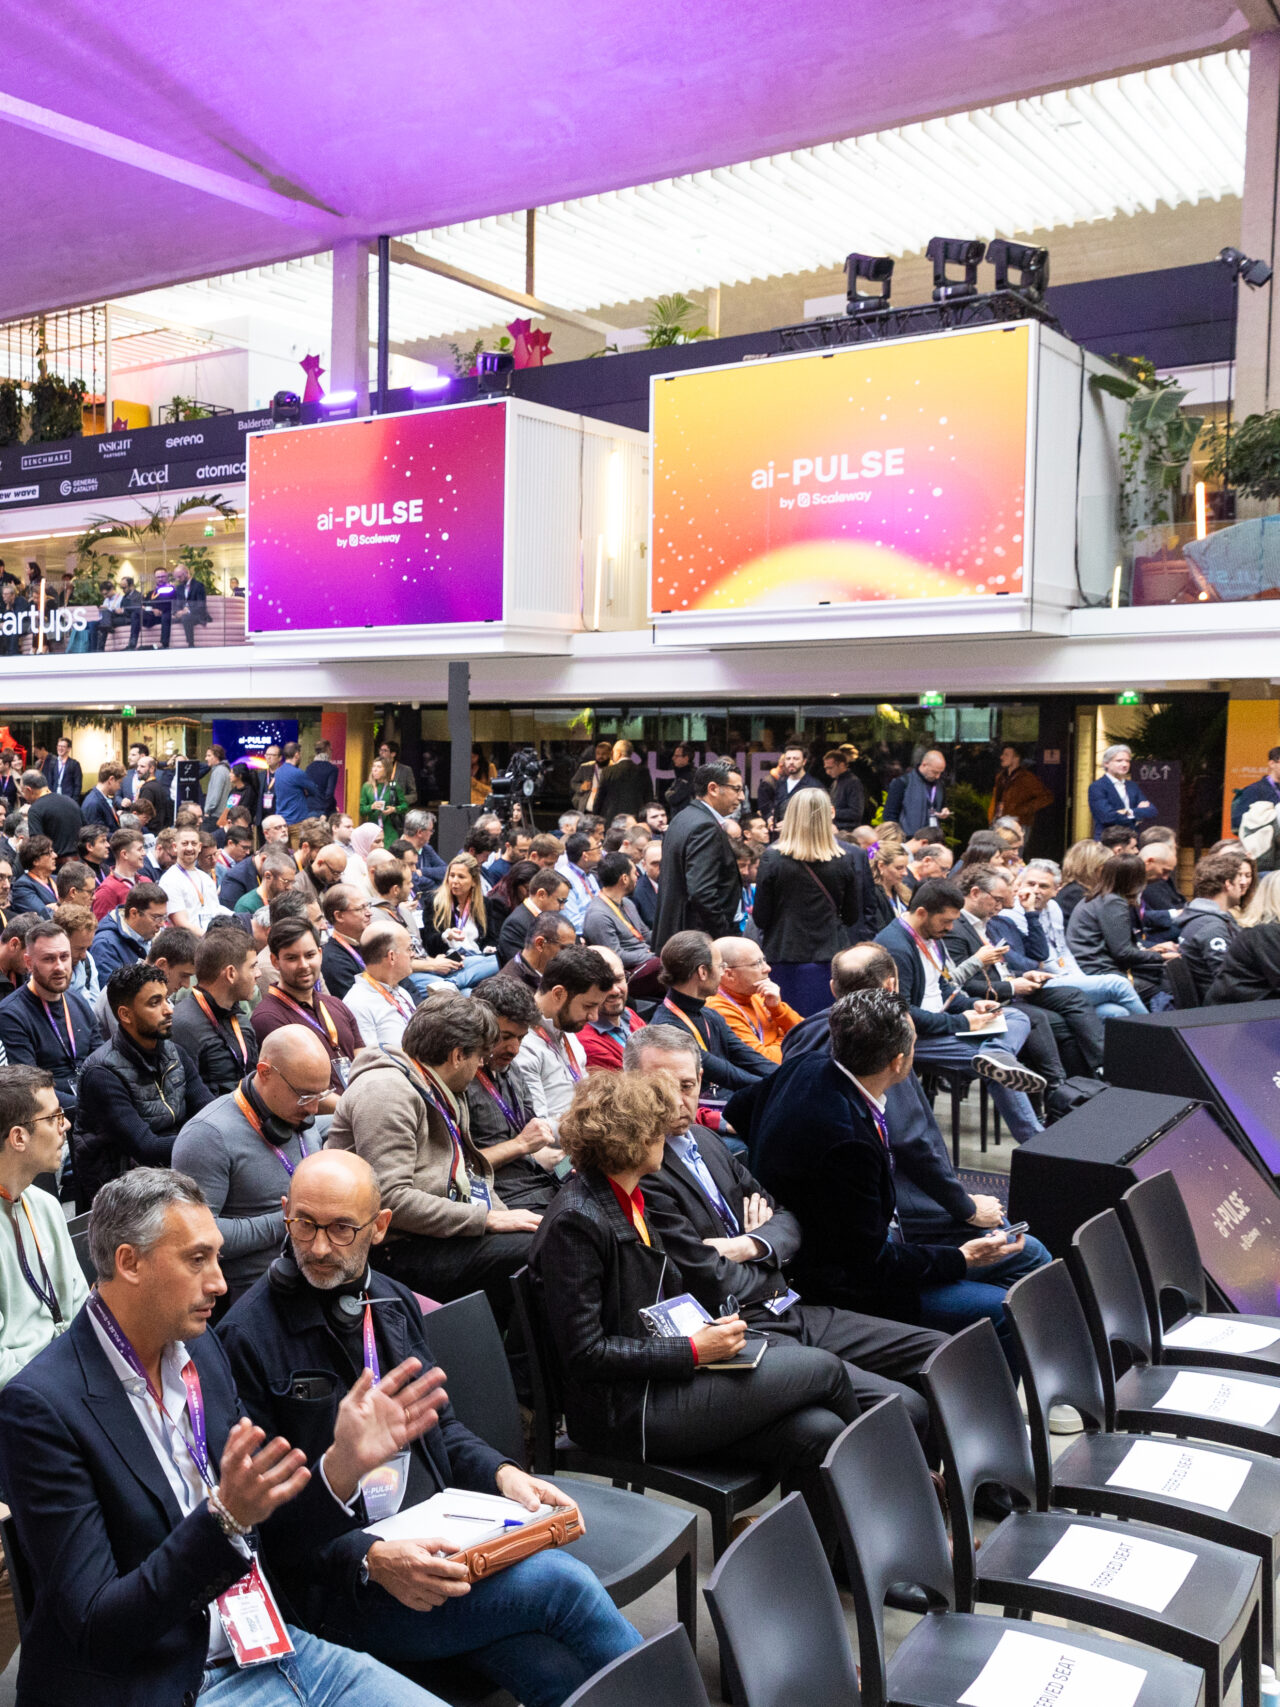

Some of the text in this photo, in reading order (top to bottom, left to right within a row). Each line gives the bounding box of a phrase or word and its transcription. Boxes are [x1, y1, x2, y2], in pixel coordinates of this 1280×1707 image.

[238, 418, 274, 430] Balderton
[98, 439, 132, 453] INSIGHT
[165, 434, 204, 448] serena
[23, 454, 68, 467] BENCHMARK
[128, 464, 168, 488] Accel
[751, 448, 905, 490] ai-PULSE
[72, 478, 98, 486] GENERAL
[72, 484, 98, 494] CATALYST
[14, 488, 36, 497] wave
[779, 490, 872, 510] by Scaleway
[316, 499, 424, 531] ai-PULSE
[336, 534, 400, 548] by Scaleway
[1212, 1190, 1251, 1238] ai-PULSE
[1090, 1542, 1134, 1589] RESERVED SEAT
[1052, 1655, 1076, 1682] SEAT
